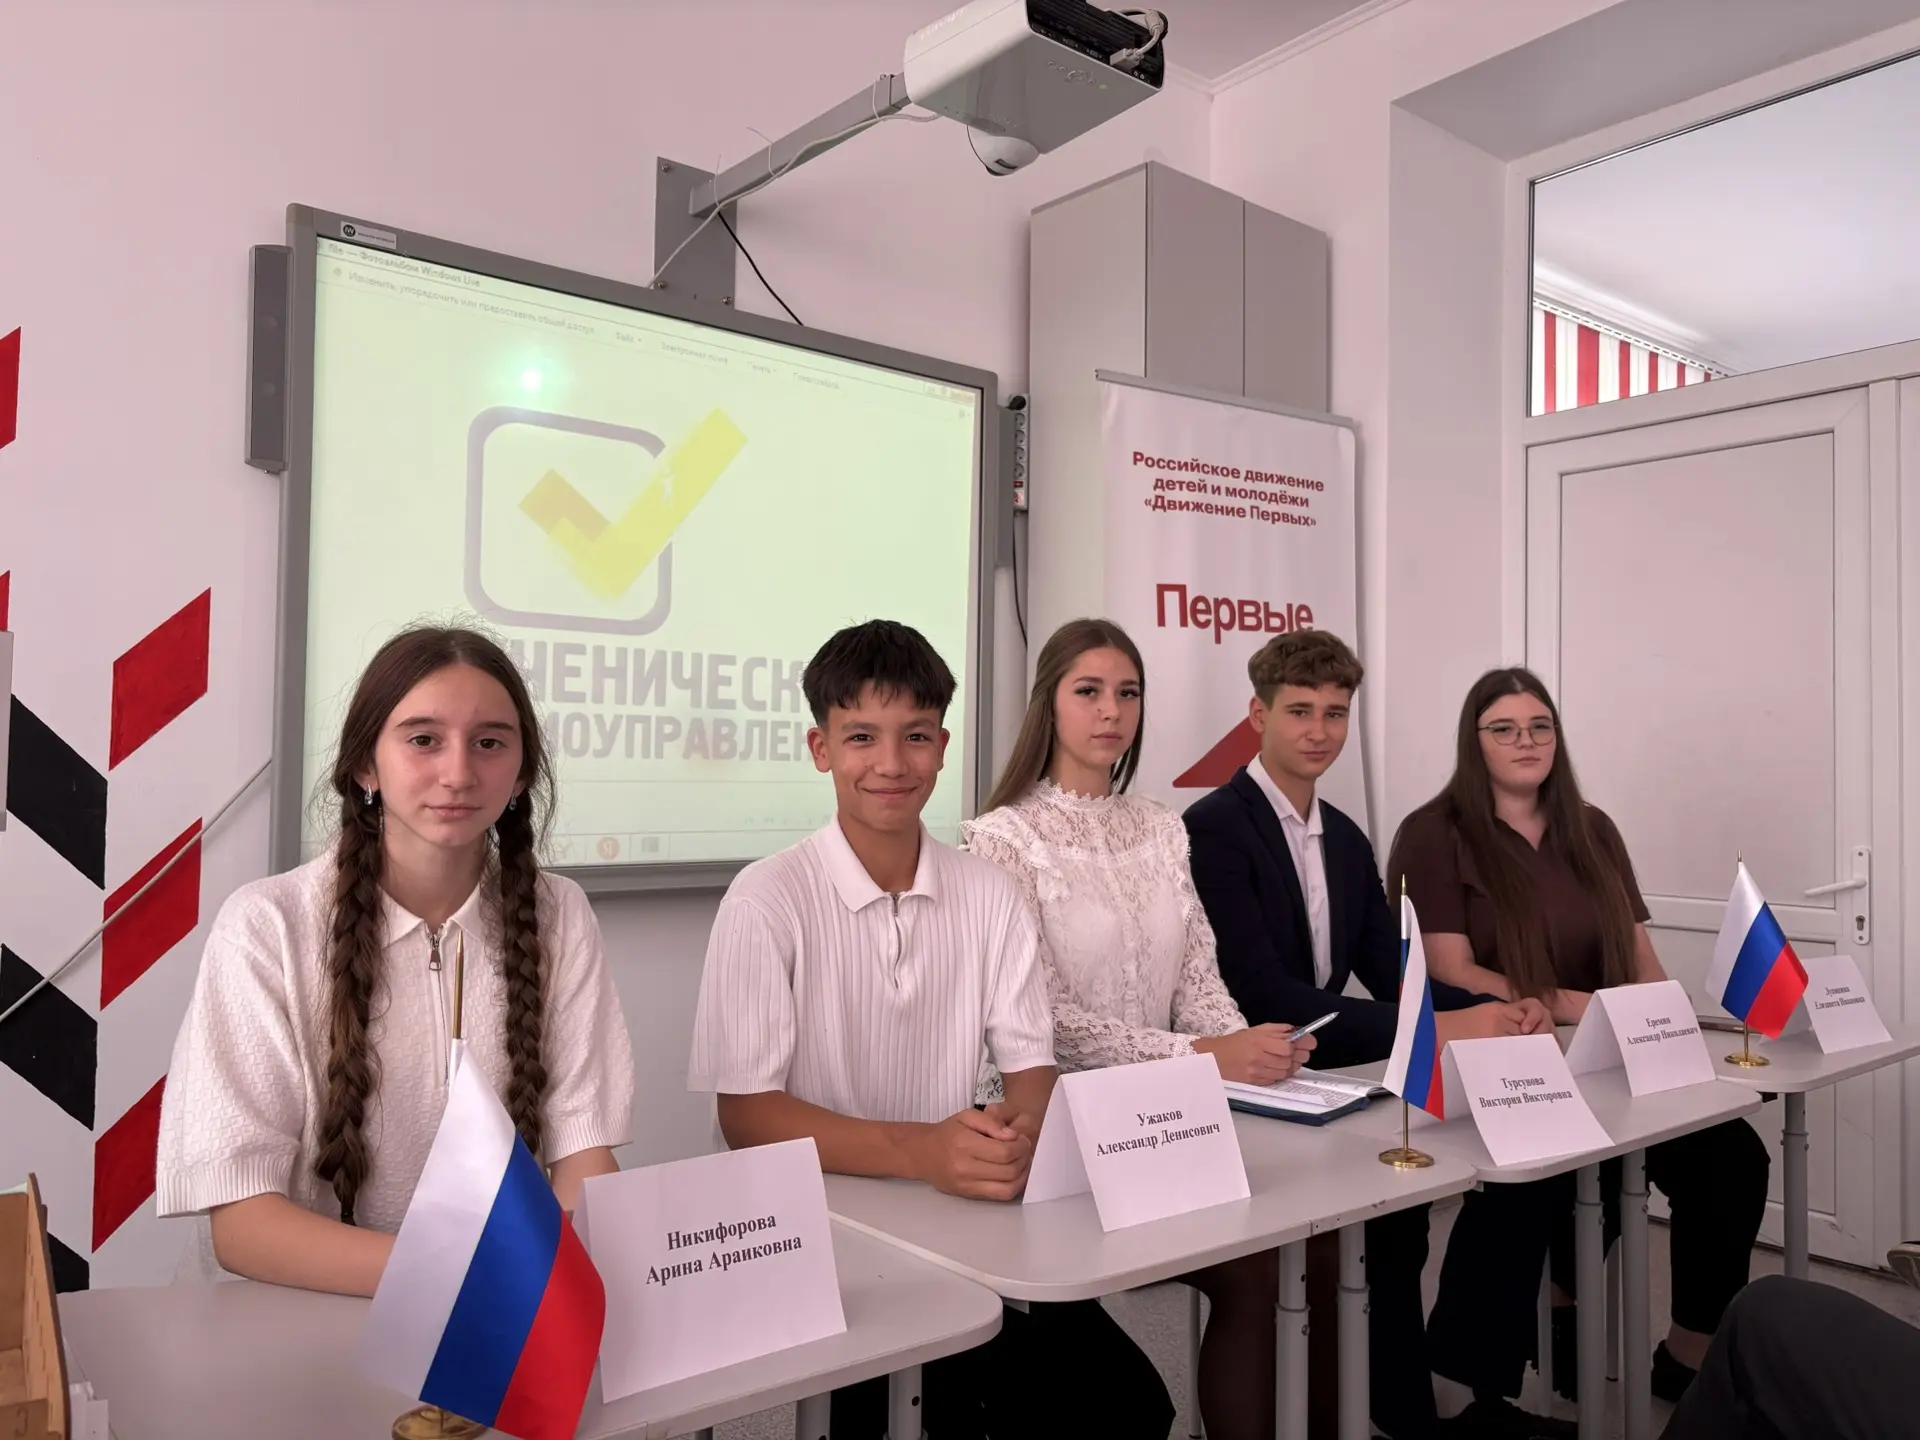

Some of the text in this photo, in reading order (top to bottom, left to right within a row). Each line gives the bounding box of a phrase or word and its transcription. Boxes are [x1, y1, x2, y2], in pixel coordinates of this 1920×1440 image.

[1132, 451, 1324, 492] Российское движение
[1153, 477, 1310, 508] детей и молодёжи
[1144, 494, 1317, 527] «Движение Первых»
[1156, 583, 1314, 645] Первые
[1626, 1033, 1661, 1045] Александр
[1479, 1090, 1573, 1108] Виктория Викторовна
[1501, 1076, 1546, 1091] Турсунова
[1136, 1109, 1183, 1127] Ужаков
[1096, 1123, 1220, 1157] Александр Денисович
[666, 1215, 777, 1251] Никифорова
[645, 1236, 802, 1286] Арина Араиковна
